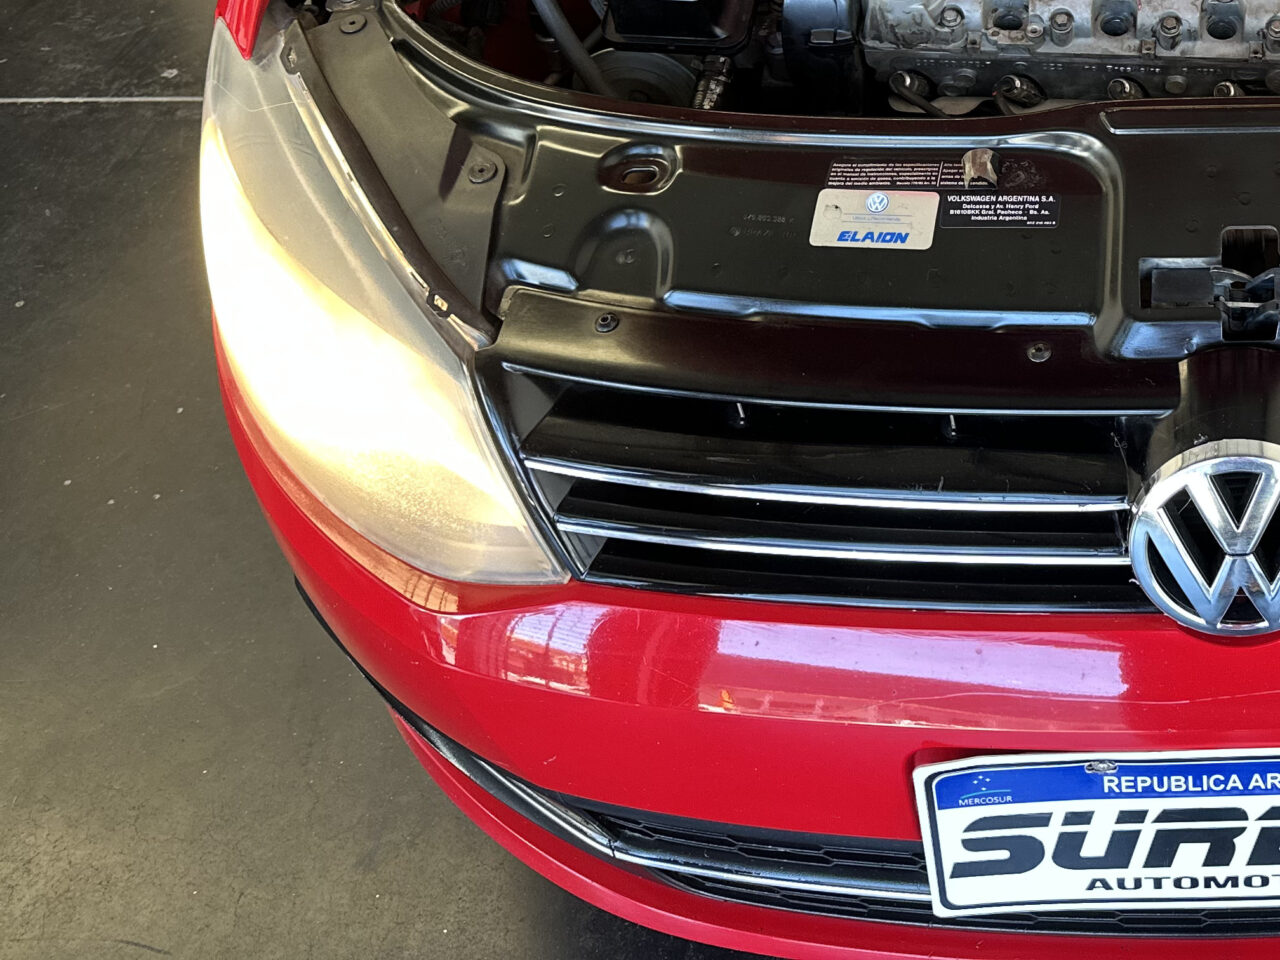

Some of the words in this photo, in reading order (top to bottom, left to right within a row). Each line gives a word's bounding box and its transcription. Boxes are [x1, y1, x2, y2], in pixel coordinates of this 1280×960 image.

[947, 195, 997, 203] VOLKSWAGEN
[998, 195, 1040, 203] ARGENTINA
[1040, 195, 1056, 203] S.A.
[836, 230, 910, 244] ELAION
[1103, 774, 1244, 794] REPUBLICA
[958, 795, 1014, 807] MERCOSUR
